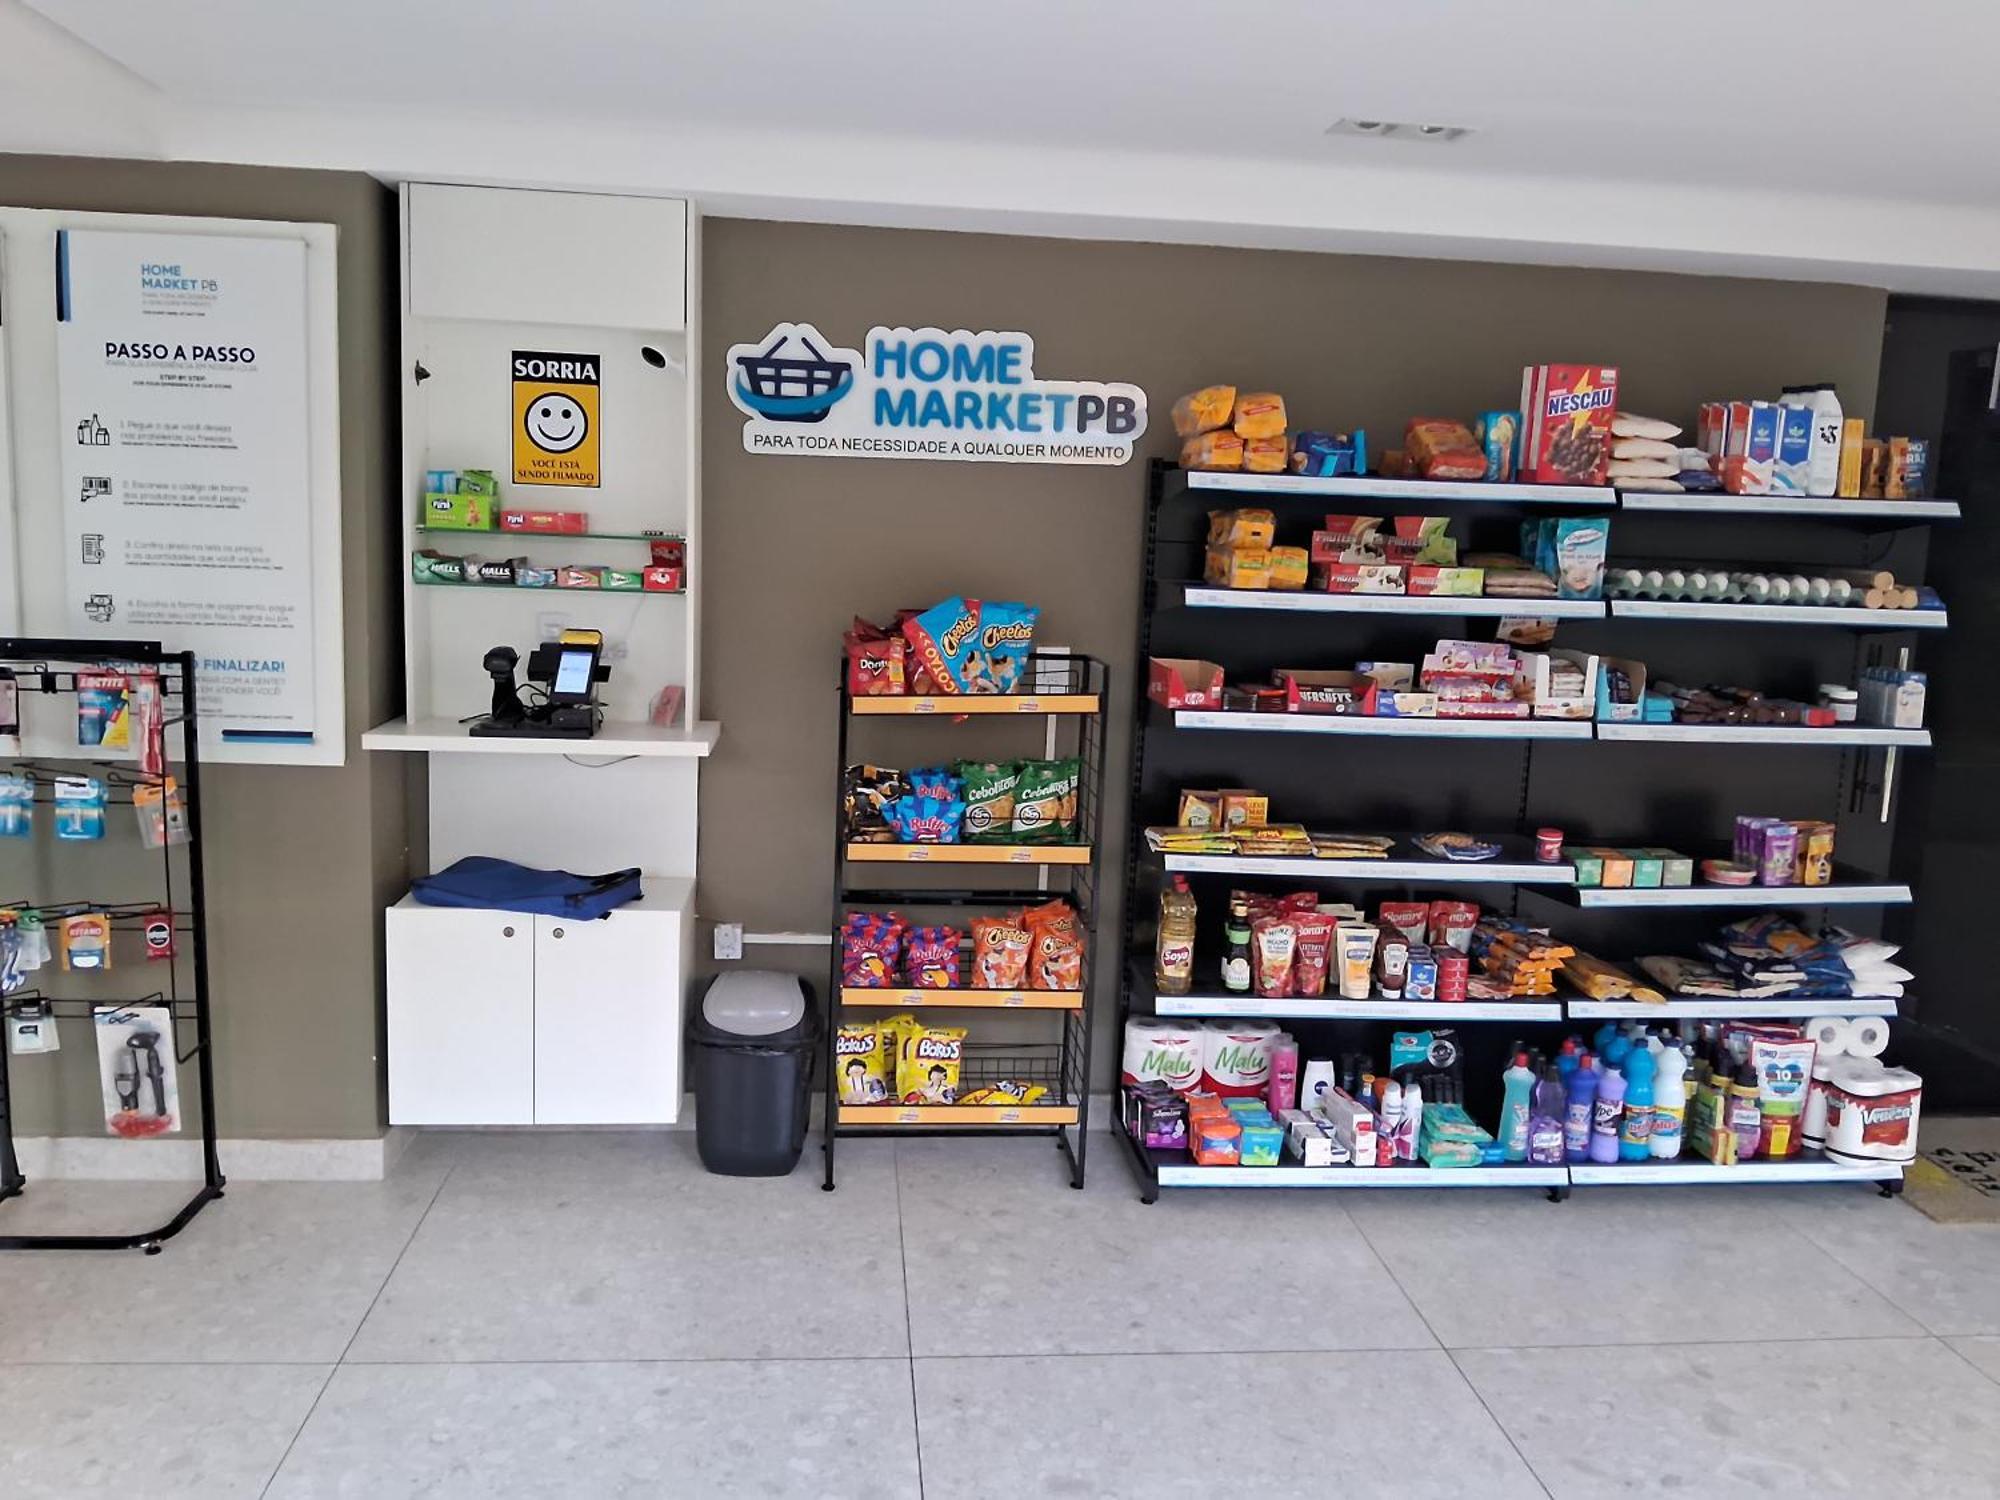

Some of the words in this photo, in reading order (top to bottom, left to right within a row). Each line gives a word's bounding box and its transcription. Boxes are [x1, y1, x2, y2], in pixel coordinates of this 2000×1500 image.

[141, 263, 182, 278] HOME
[141, 277, 199, 292] MARKET
[201, 279, 219, 292] PB
[105, 341, 168, 360] PASSO
[172, 344, 193, 361] A
[192, 345, 256, 364] PASSO
[874, 338, 1022, 386] HOME
[514, 358, 597, 381] SORRIA
[1547, 386, 1614, 417] NESCAU
[753, 433, 794, 449] PARA
[797, 435, 839, 450] TODA
[841, 437, 949, 455] NECESSIDADE
[950, 442, 961, 455] A
[963, 442, 1046, 458] QUALQUER
[1049, 444, 1125, 460] MOMENTO
[559, 459, 581, 470] ESTÁ
[517, 468, 550, 480] SENDO
[552, 470, 595, 481] FILMADO
[430, 562, 461, 575] HALLS
[480, 564, 512, 577] HALLS
[941, 614, 977, 658] Cheetos
[982, 623, 1034, 649] Cheetos
[203, 658, 286, 673] FINALIZAR!
[987, 927, 1033, 946] Cheetos
[1163, 949, 1190, 964] Soya
[1141, 1050, 1192, 1077] Malu
[1215, 1046, 1264, 1075] Malu
[1775, 1069, 1792, 1082] 10
